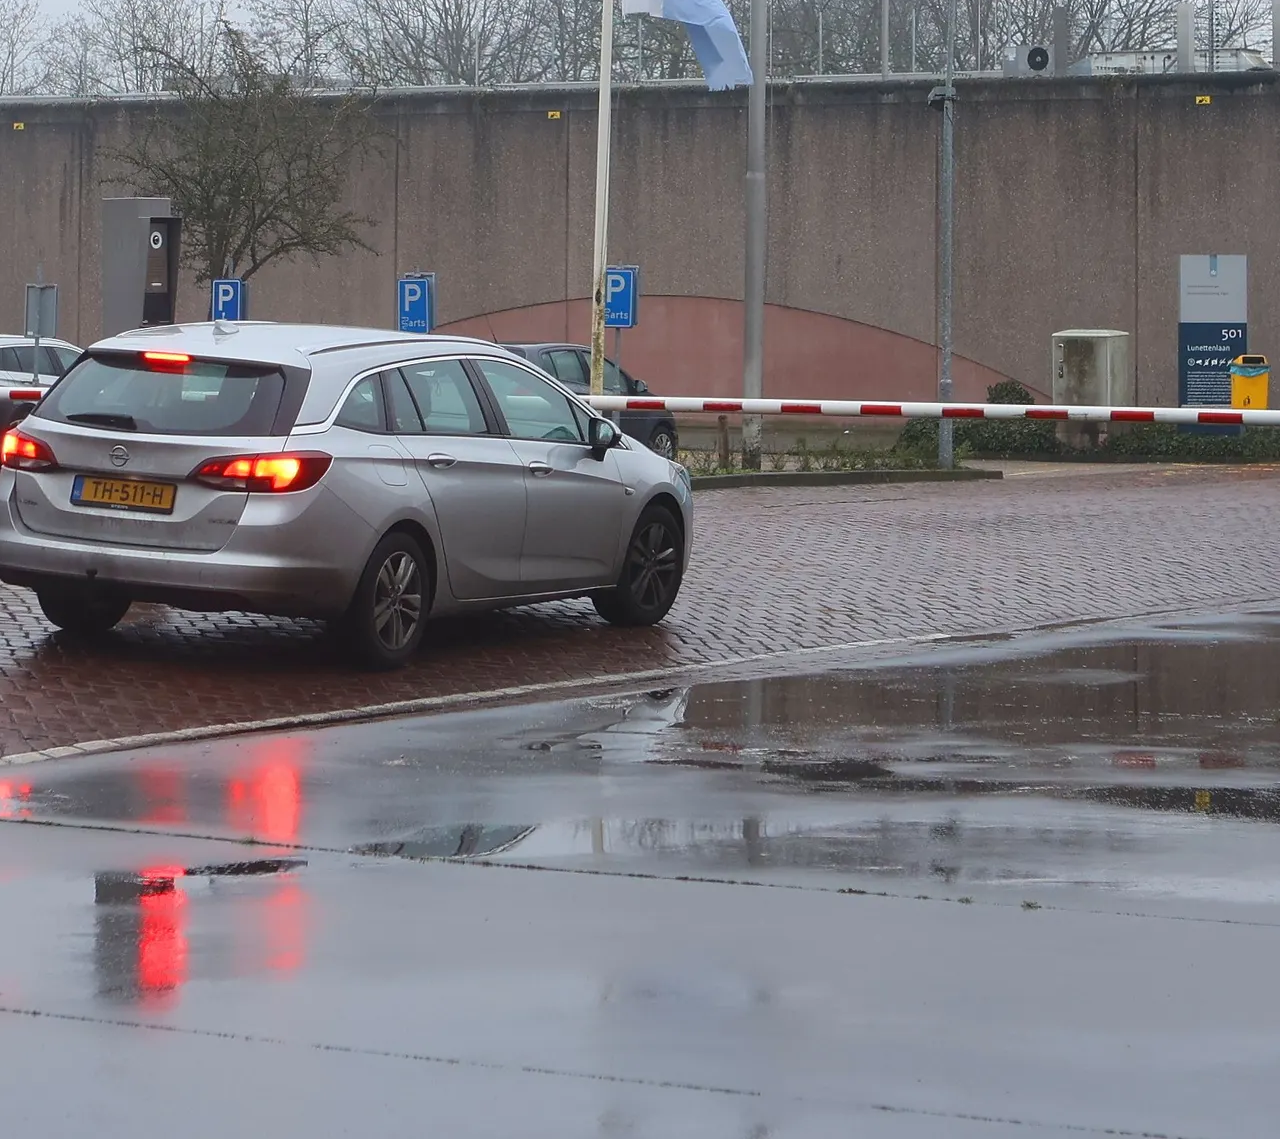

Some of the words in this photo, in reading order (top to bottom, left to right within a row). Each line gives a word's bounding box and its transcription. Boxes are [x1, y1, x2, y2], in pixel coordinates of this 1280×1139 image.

[218, 284, 234, 311] P
[404, 283, 421, 312] P
[606, 274, 625, 303] P
[408, 319, 426, 327] arts
[610, 310, 629, 320] arts
[1221, 329, 1242, 341] 501
[1187, 344, 1231, 352] Lunettenlaan
[92, 480, 164, 505] TH-511-H
